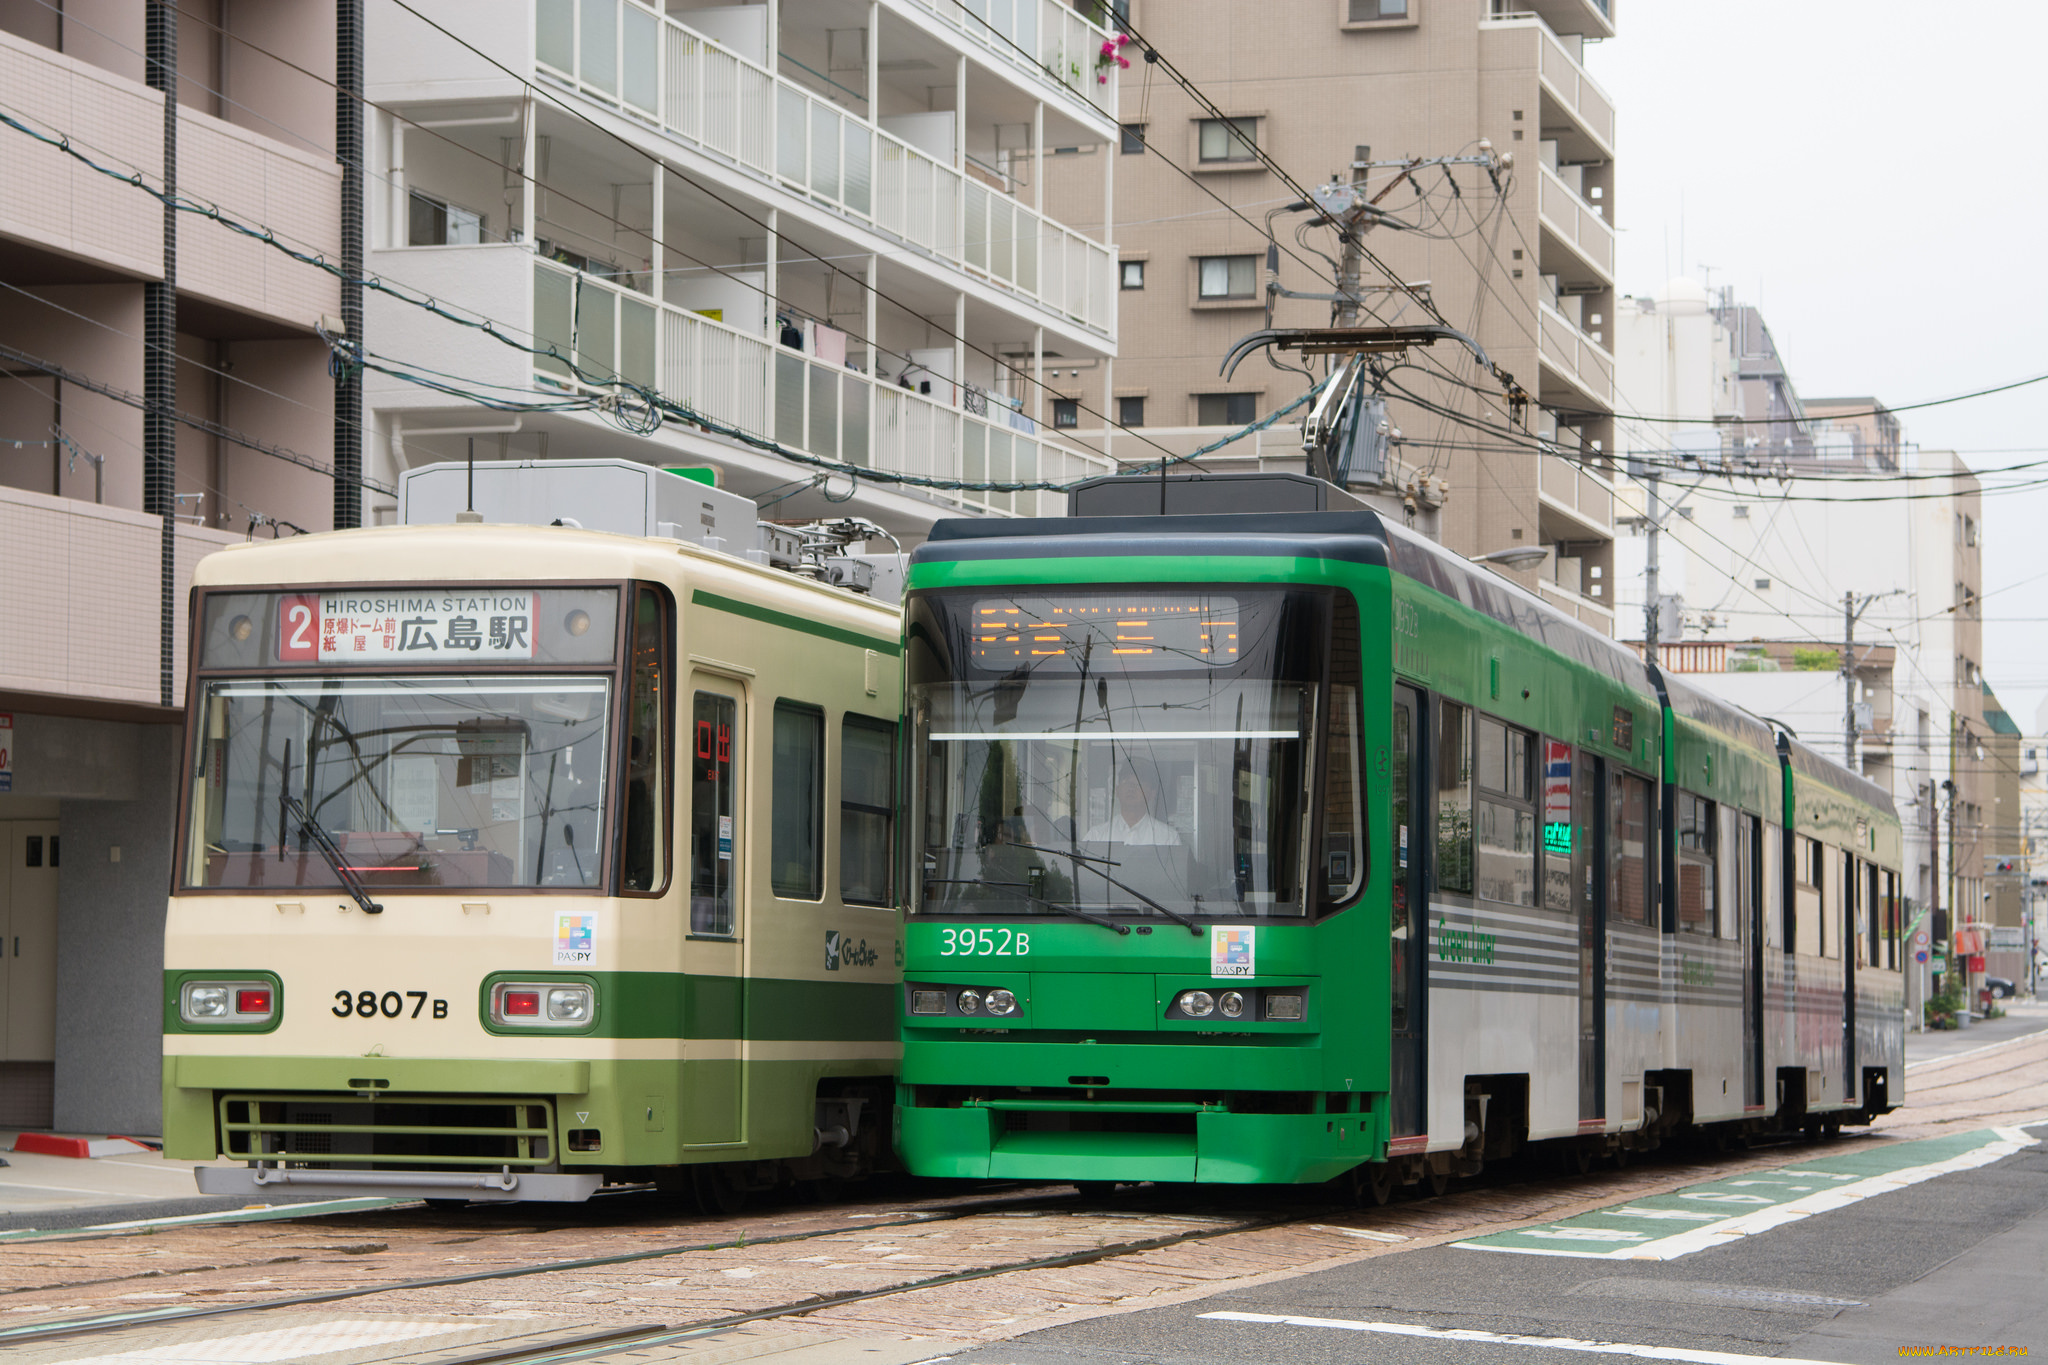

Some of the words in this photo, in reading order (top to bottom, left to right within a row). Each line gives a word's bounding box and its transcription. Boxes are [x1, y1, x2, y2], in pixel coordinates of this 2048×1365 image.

[326, 597, 436, 614] HIROSHIMA
[442, 596, 527, 612] STATION
[288, 604, 312, 649] 2
[323, 617, 397, 635] 原爆ドーム前
[397, 614, 528, 651] 広島駅
[940, 928, 1030, 956] 3952B
[557, 951, 591, 963] PASPY
[1215, 965, 1250, 976] PASPY
[331, 990, 449, 1020] 3807B
